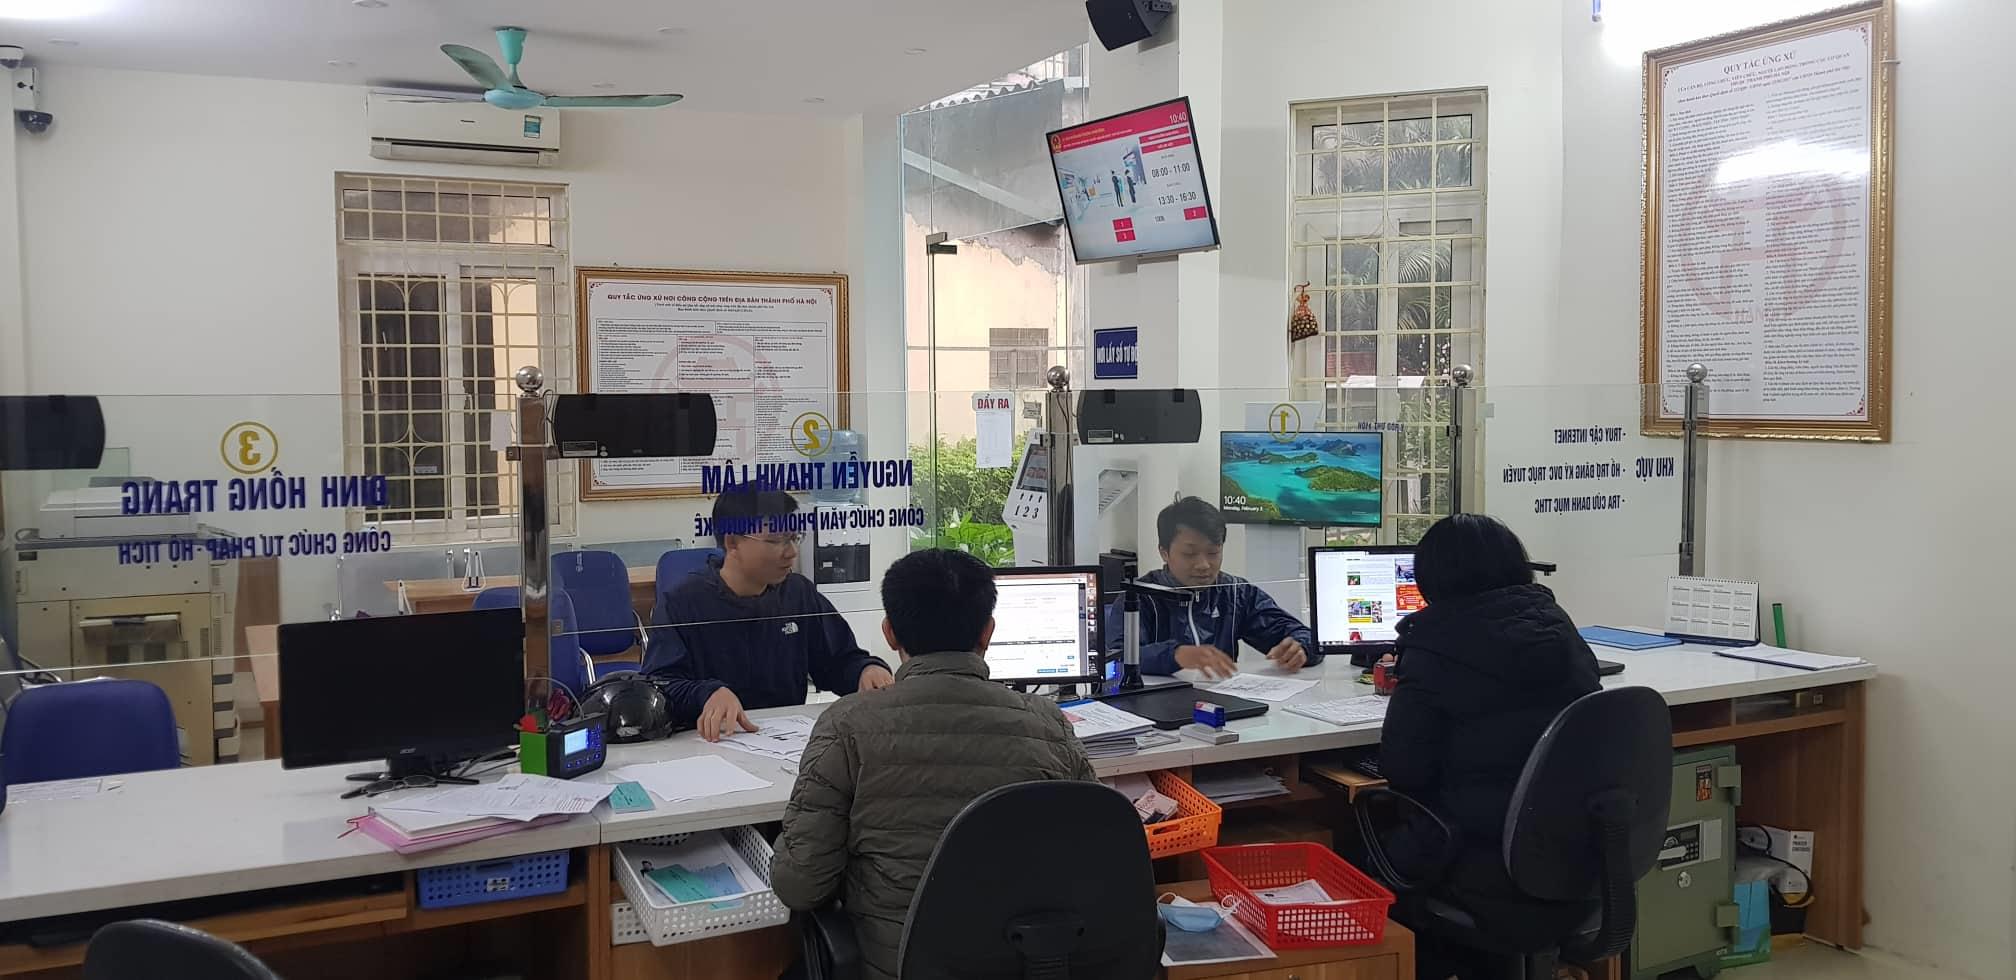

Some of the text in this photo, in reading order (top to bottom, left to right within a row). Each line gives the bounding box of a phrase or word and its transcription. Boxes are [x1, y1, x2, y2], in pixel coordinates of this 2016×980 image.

[1723, 63, 1741, 74] QUY
[1169, 112, 1187, 124] 10:40
[1151, 166, 1169, 178] 08:00
[1173, 162, 1191, 174] 11:00
[1158, 194, 1175, 205] 13:30
[1179, 191, 1197, 202] 16:30
[998, 398, 1010, 409] RA
[1224, 495, 1246, 504] 10:40
[1015, 506, 1039, 519] 1 2 3
